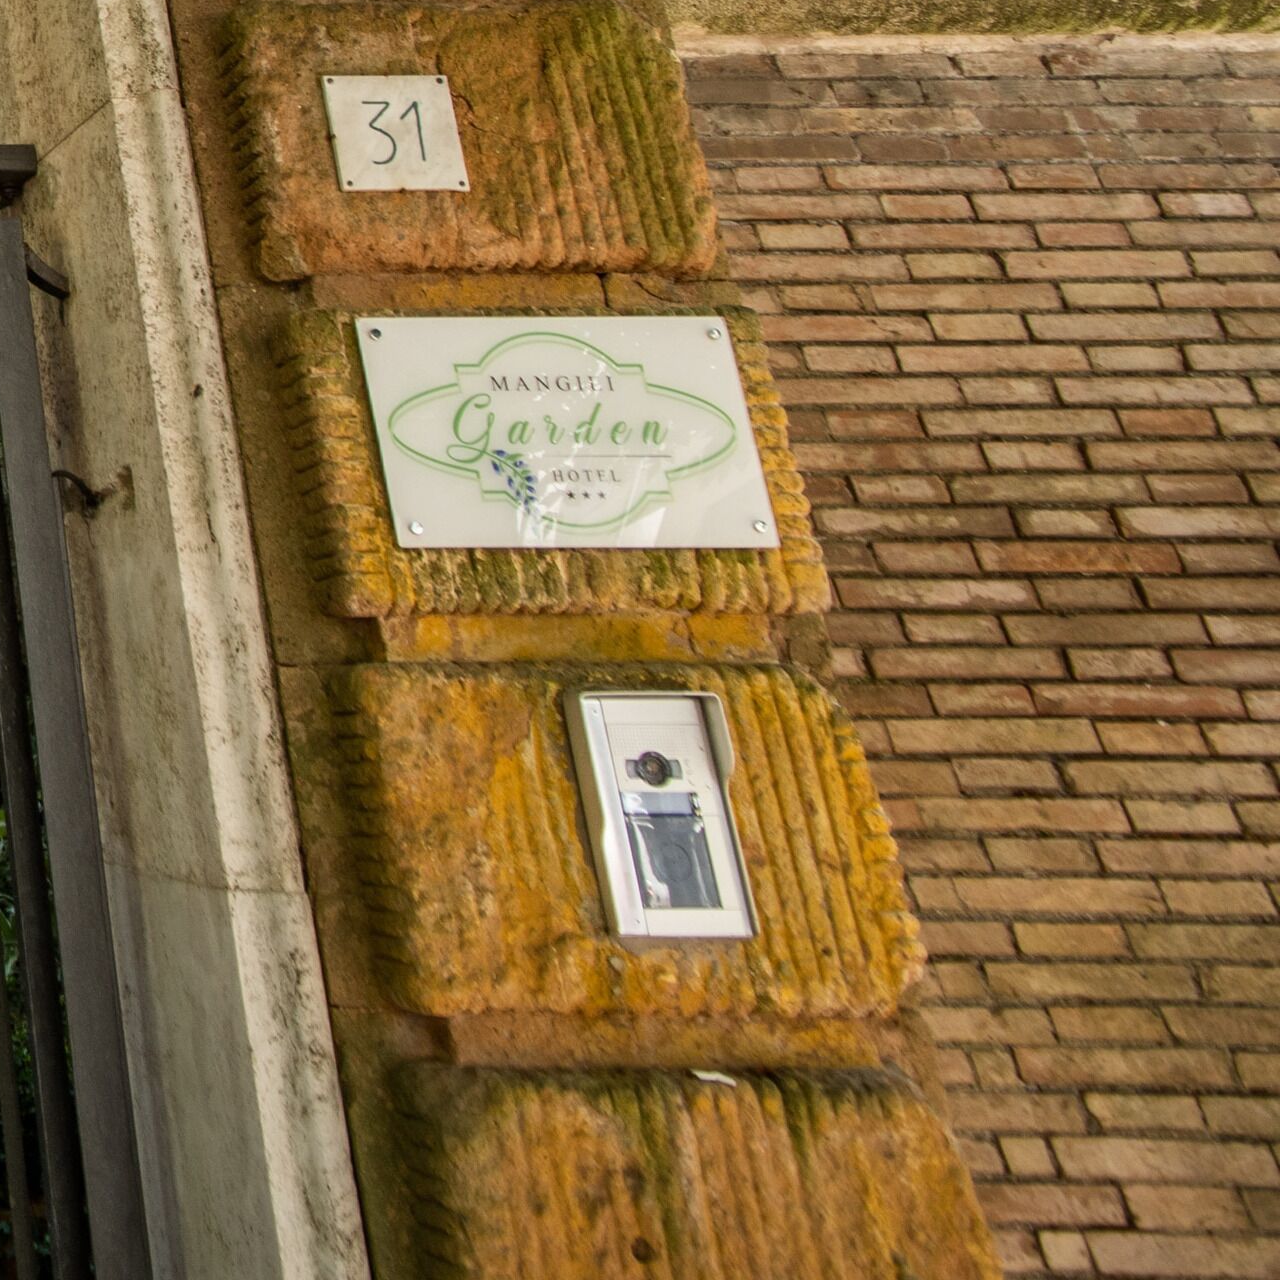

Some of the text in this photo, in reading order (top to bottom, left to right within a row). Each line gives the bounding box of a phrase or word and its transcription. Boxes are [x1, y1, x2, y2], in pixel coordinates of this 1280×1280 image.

[360, 100, 427, 165] 31
[490, 375, 615, 392] MANGILI
[446, 393, 668, 463] Garden
[551, 469, 623, 483] HOTEL
